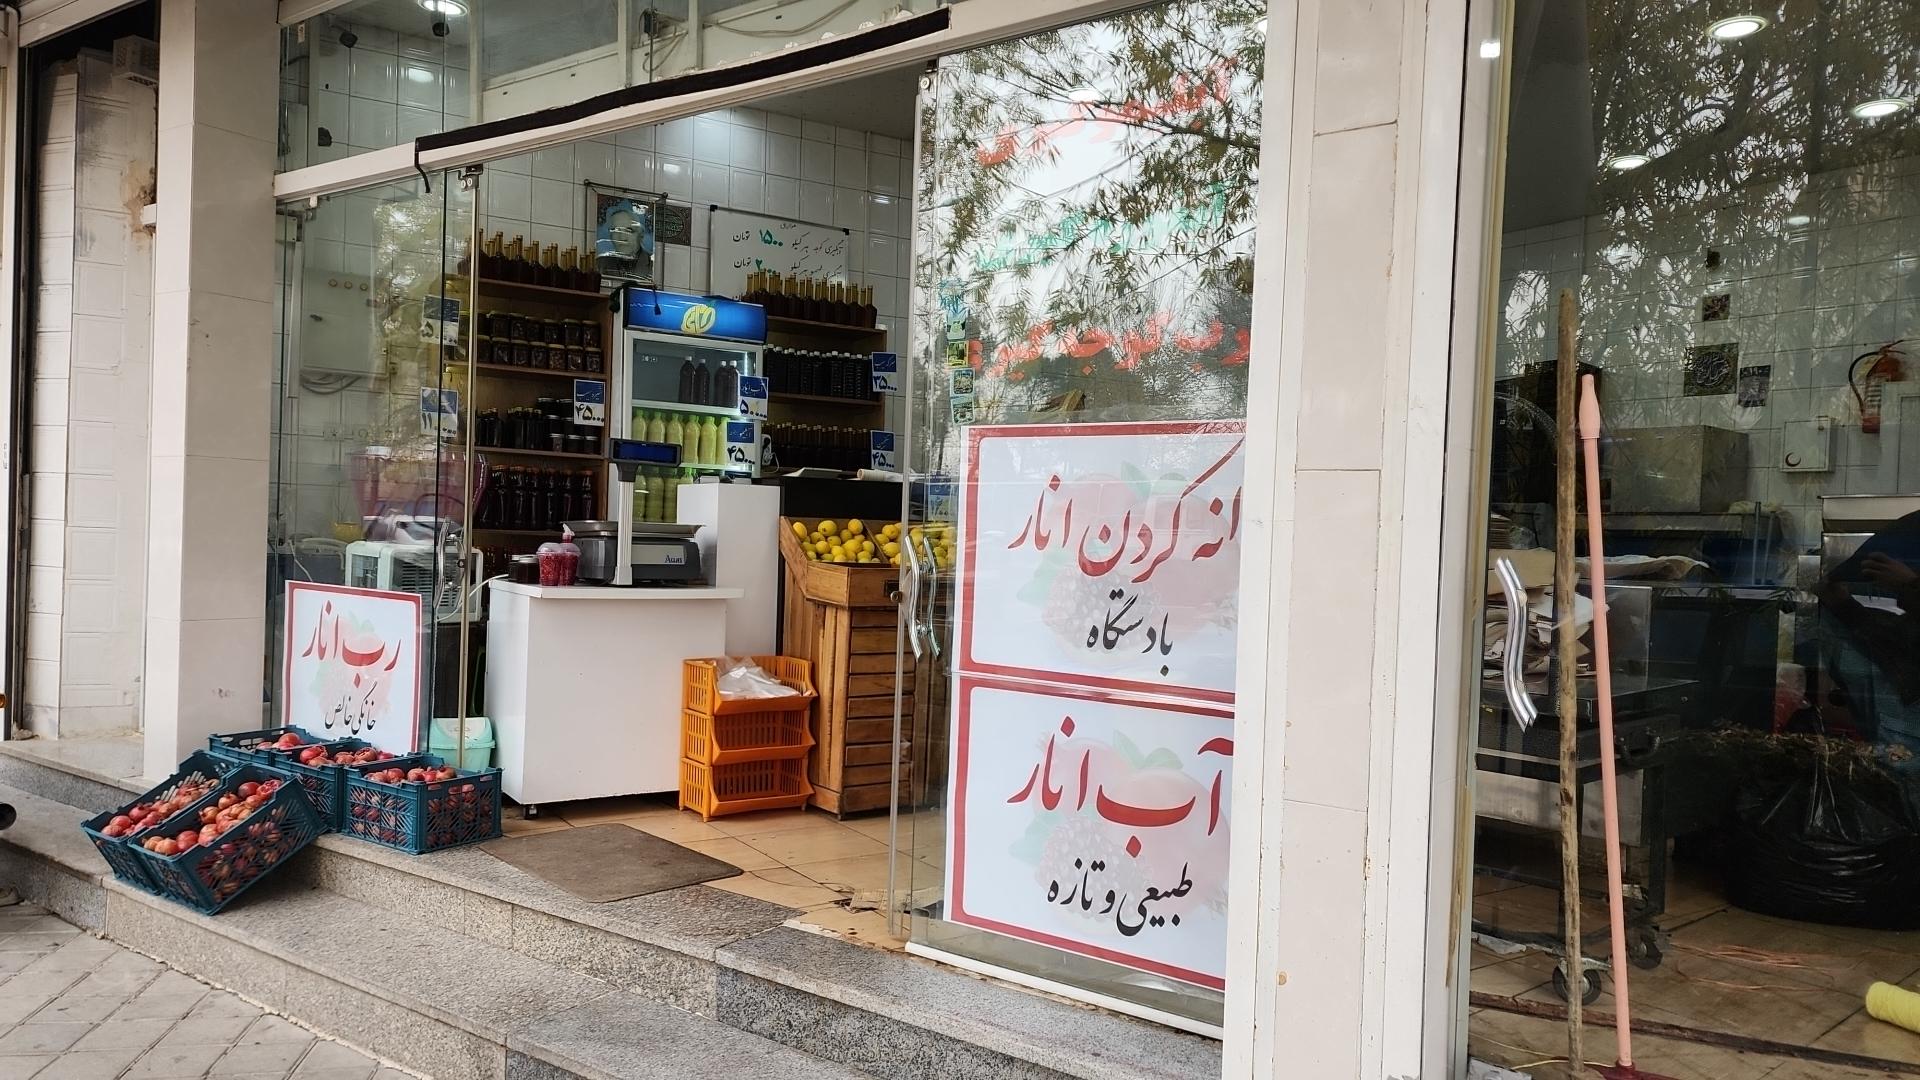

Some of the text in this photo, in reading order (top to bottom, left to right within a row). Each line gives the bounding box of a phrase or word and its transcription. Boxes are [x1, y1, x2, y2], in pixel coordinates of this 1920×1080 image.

[732, 230, 751, 242] تومان
[575, 404, 605, 422] ۴۵۰۰۰
[727, 446, 755, 465] ۴۵۰۰۰
[1007, 435, 1245, 584] انه کردن انار
[302, 600, 402, 689] رب انار
[1087, 588, 1174, 677] با دستگاه
[324, 681, 378, 735] خانگی خالص
[1006, 715, 1235, 859] آب انار
[1047, 857, 1106, 911] تازه
[1116, 861, 1194, 937] طبیعی
